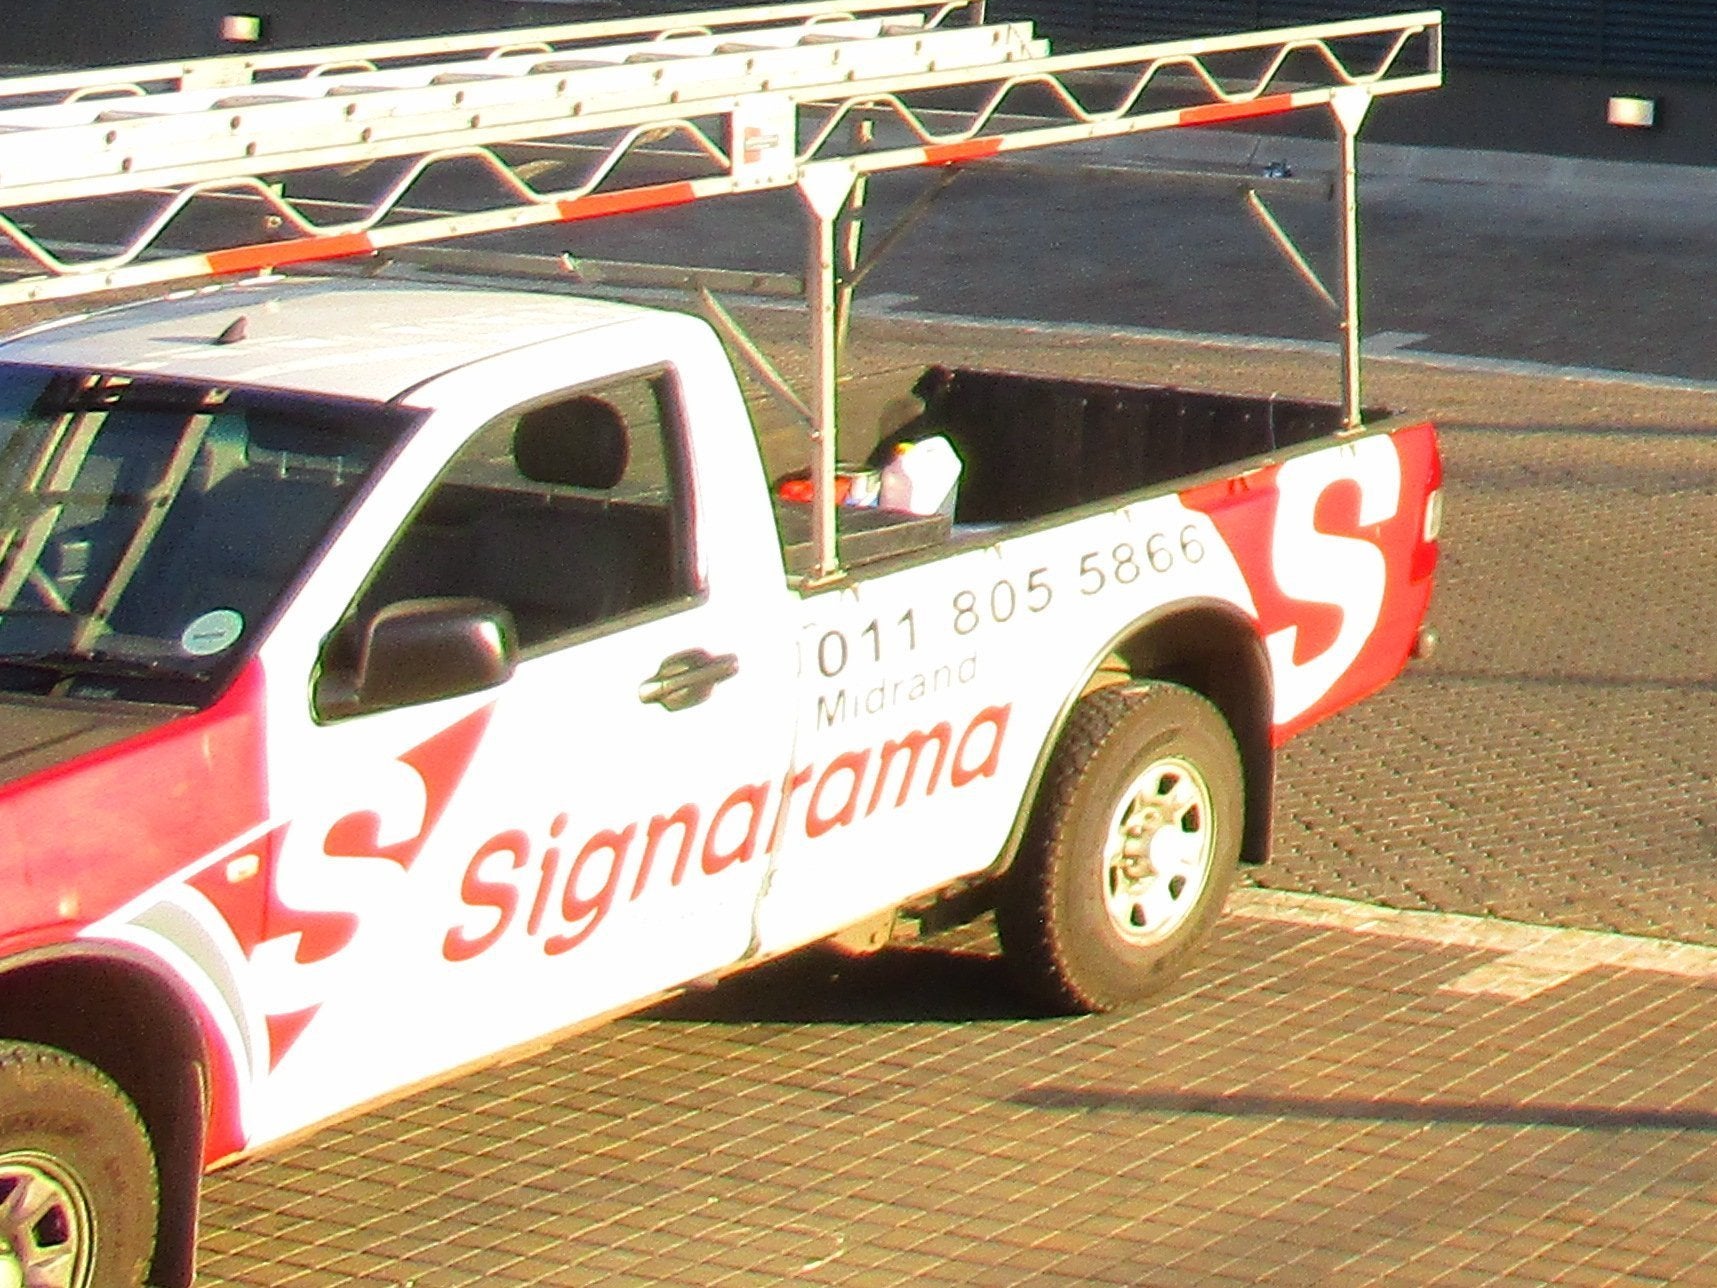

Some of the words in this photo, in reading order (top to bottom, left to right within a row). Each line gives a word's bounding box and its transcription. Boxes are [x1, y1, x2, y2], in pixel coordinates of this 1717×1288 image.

[816, 607, 917, 678] 011
[952, 566, 1053, 636] 805
[1078, 523, 1206, 596] 5866
[814, 651, 977, 732] Midrand
[442, 702, 1012, 962] Signarama
